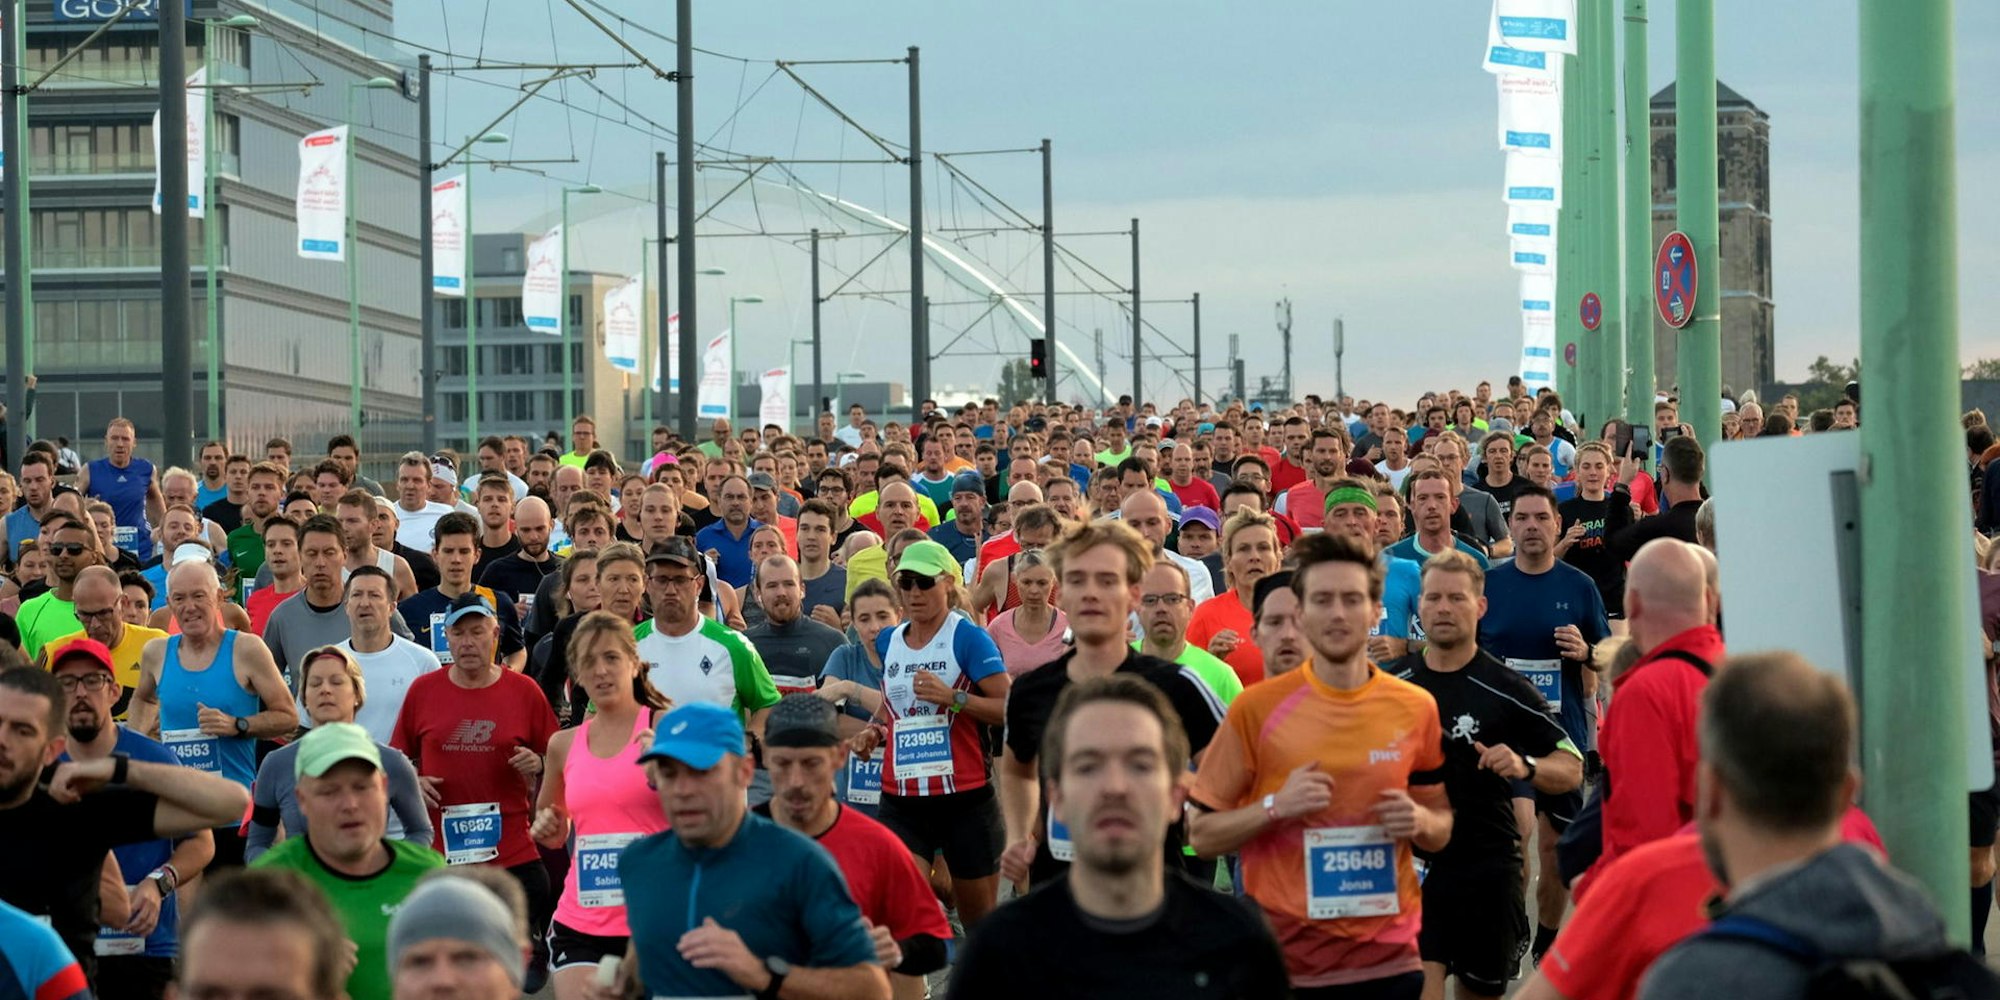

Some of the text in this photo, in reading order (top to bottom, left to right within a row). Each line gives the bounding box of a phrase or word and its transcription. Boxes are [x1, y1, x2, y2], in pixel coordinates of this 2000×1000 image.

[905, 661, 947, 673] BECKER
[898, 731, 945, 748] F23995
[916, 750, 948, 759] Johanna
[1369, 750, 1402, 765] pwc
[1323, 849, 1386, 872] 25648
[1338, 880, 1374, 892] Jonas
